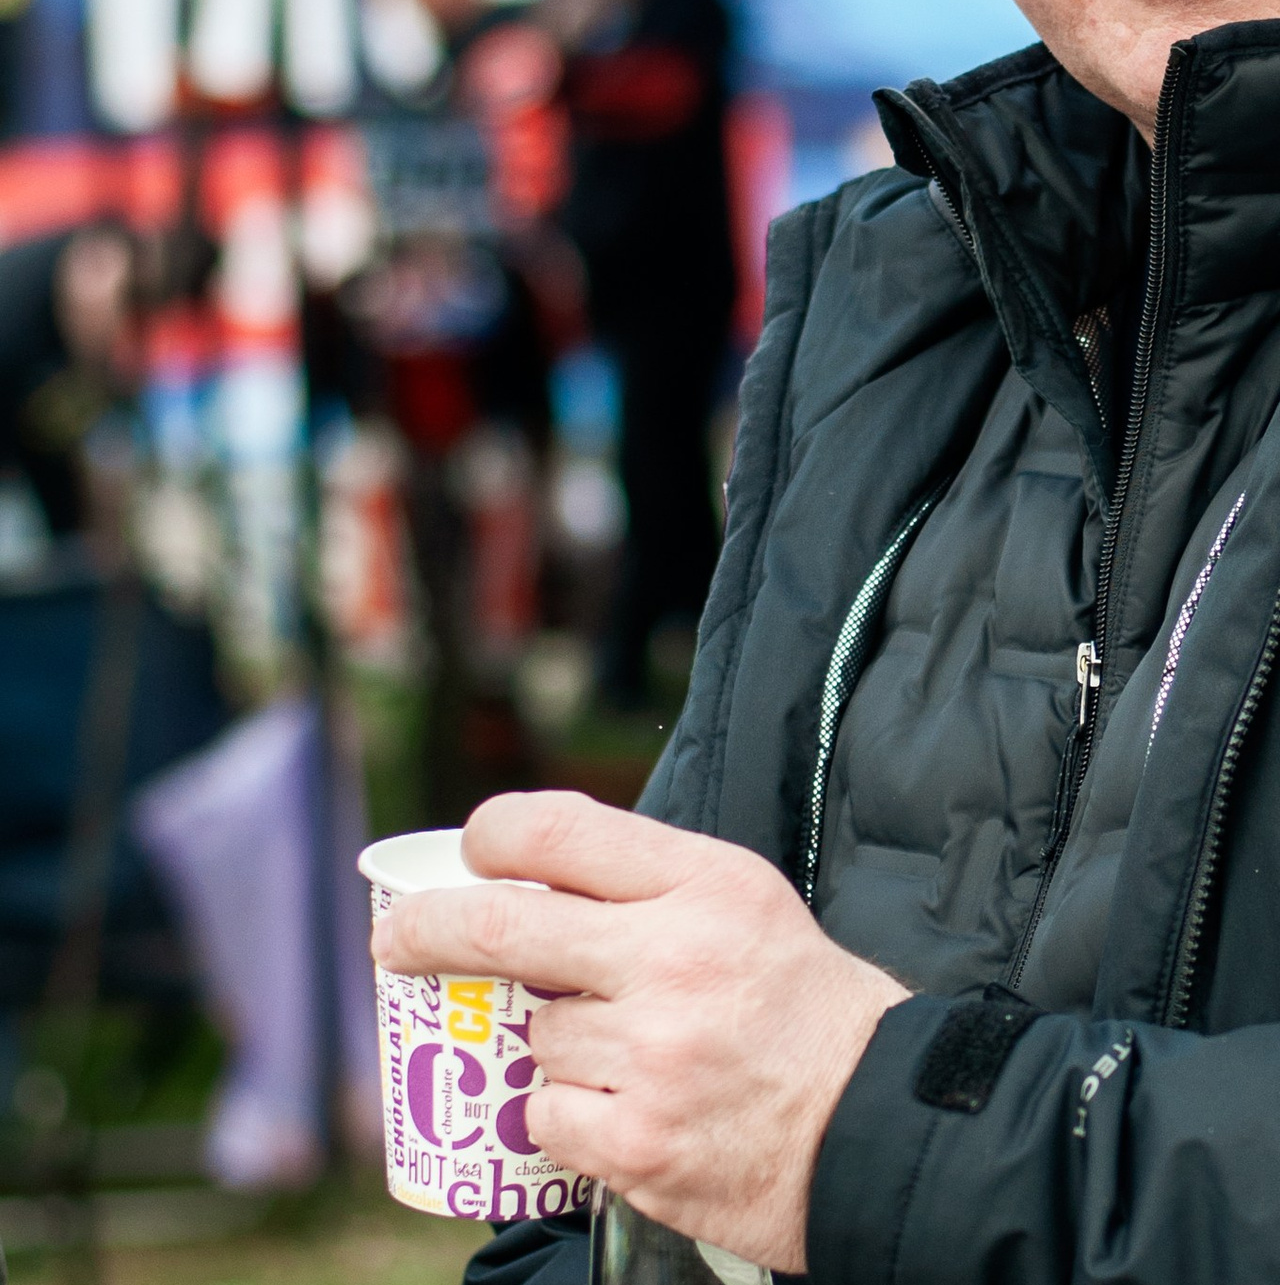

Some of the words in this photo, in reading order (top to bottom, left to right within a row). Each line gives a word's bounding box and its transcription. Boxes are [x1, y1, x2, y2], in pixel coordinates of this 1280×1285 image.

[498, 980, 515, 1017] chocol
[388, 994, 405, 1169] CHOCOLATE
[441, 1068, 453, 1135] chocolate
[1072, 1027, 1133, 1138] TECH
[464, 1101, 491, 1120] HOT
[408, 1146, 448, 1190] HOT
[453, 1157, 483, 1180] tea
